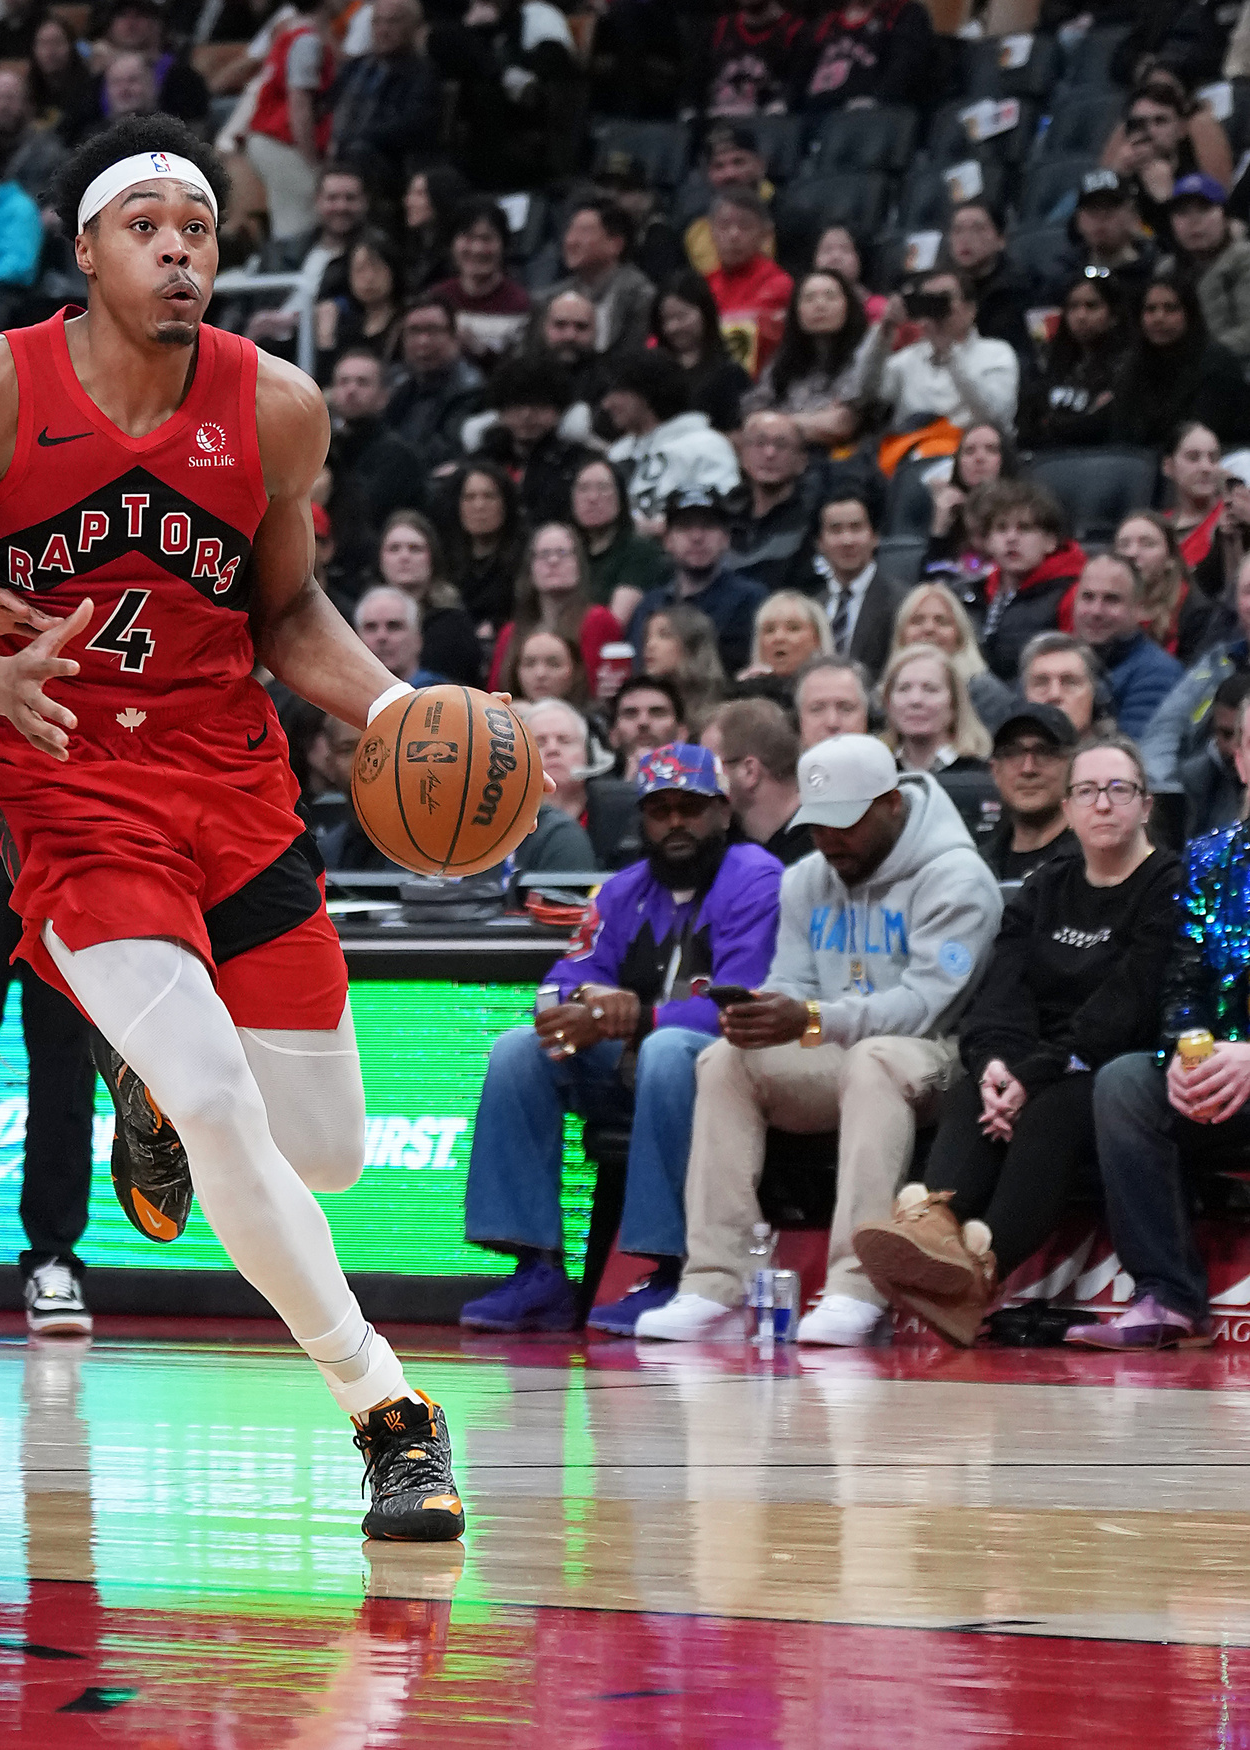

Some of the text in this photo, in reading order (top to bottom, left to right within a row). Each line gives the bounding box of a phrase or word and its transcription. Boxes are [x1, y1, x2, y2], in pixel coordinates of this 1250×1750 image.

[188, 454, 235, 467] Sun Life
[8, 493, 241, 595] RAPTORS
[85, 588, 156, 674] 4
[471, 707, 517, 826] Wilson
